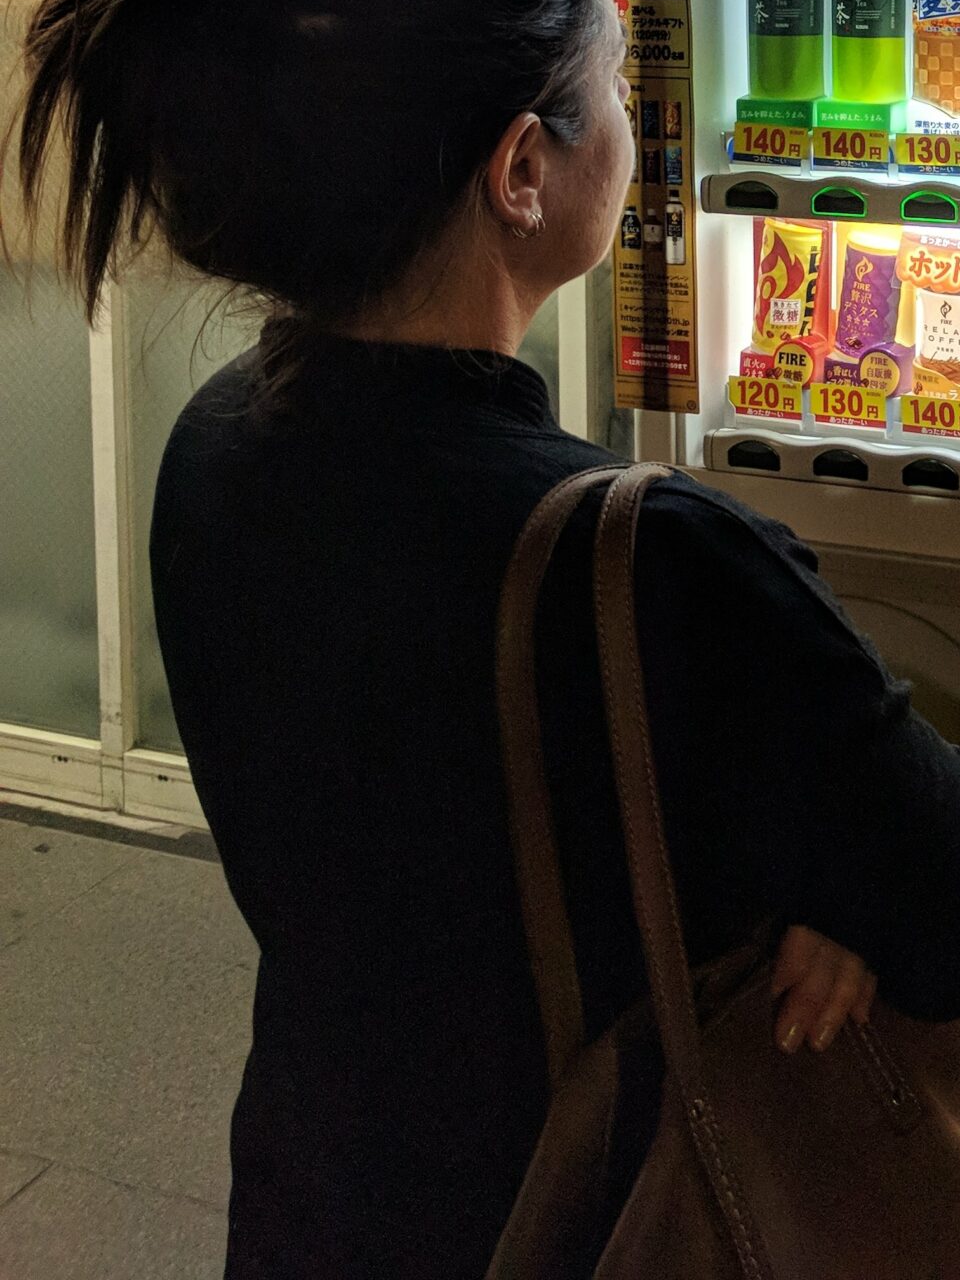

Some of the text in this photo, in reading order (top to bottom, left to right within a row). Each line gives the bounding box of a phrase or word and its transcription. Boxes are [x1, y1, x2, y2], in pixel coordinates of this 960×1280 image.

[743, 126, 800, 157] 140円
[821, 131, 882, 160] 140円
[779, 352, 807, 367] FIRE
[737, 380, 795, 411] 120円
[820, 388, 878, 419] 130円
